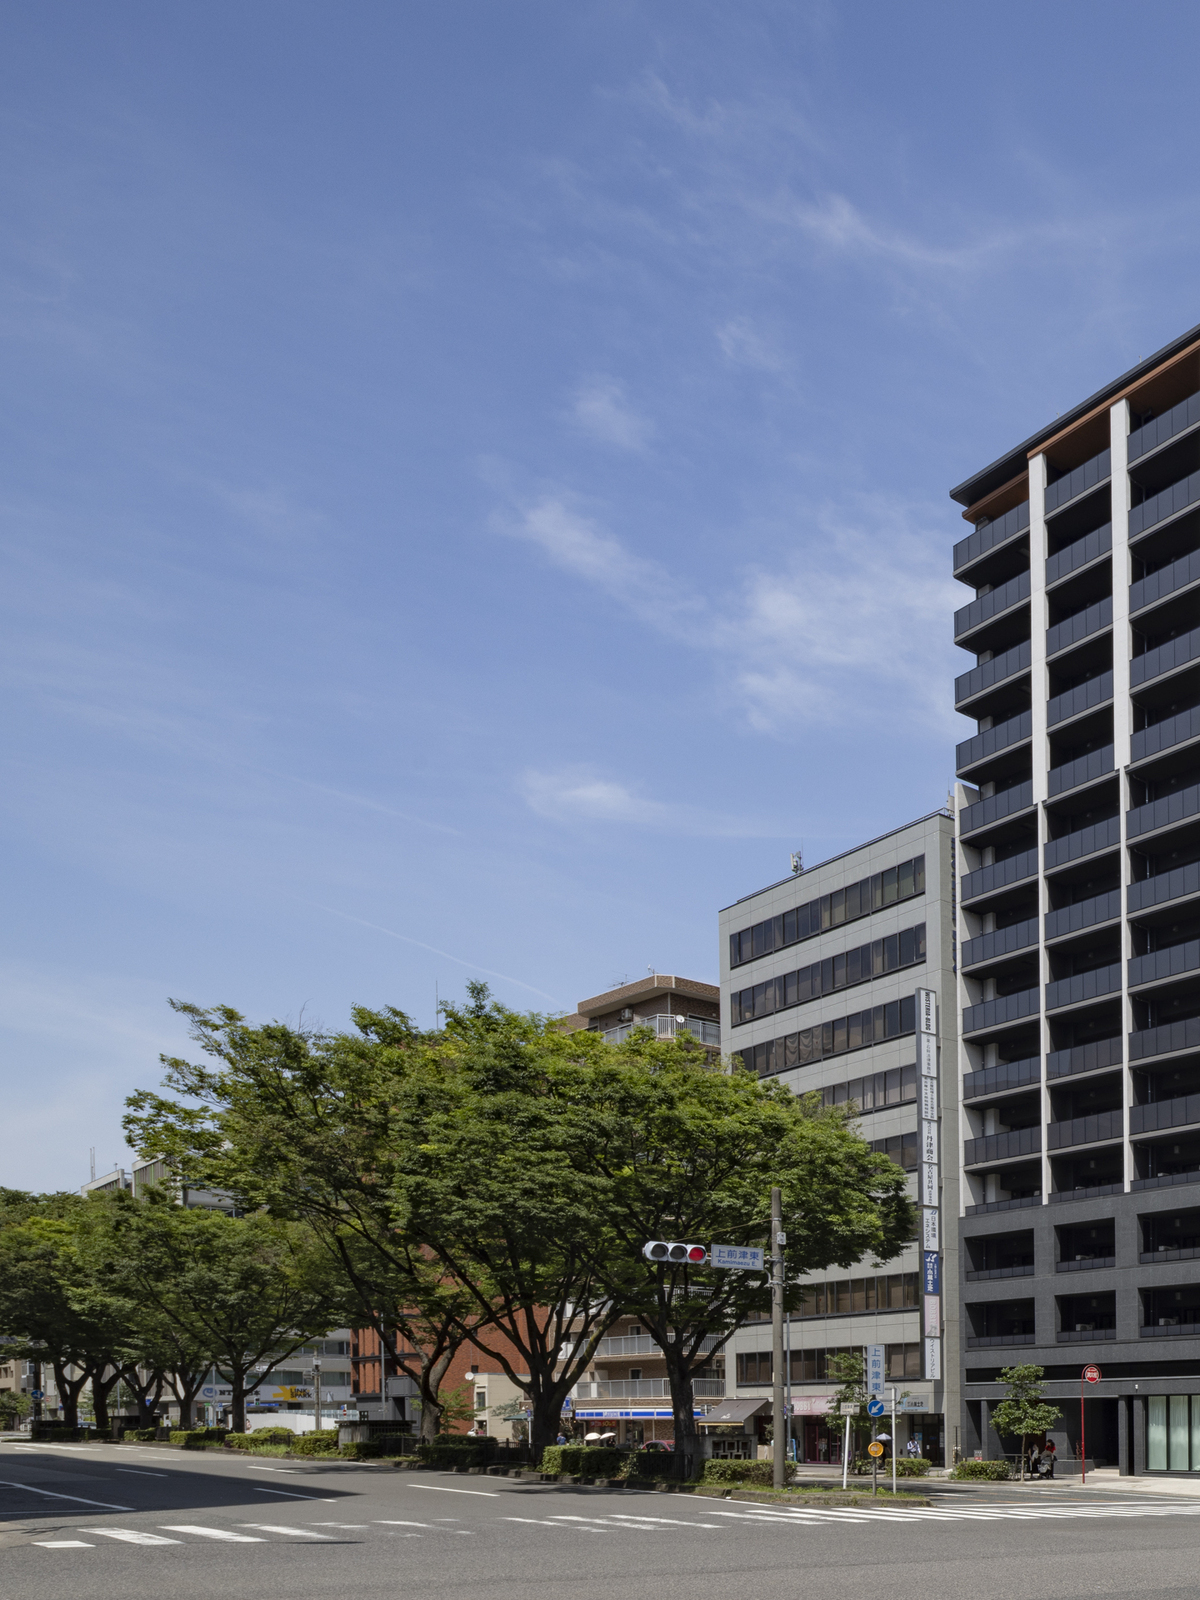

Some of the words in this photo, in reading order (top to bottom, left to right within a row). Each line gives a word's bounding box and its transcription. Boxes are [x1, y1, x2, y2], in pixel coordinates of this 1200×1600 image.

[716, 1249, 760, 1261] 上前津東
[717, 1259, 750, 1267] Kamimaezu
[871, 1347, 881, 1392] 上前津東
